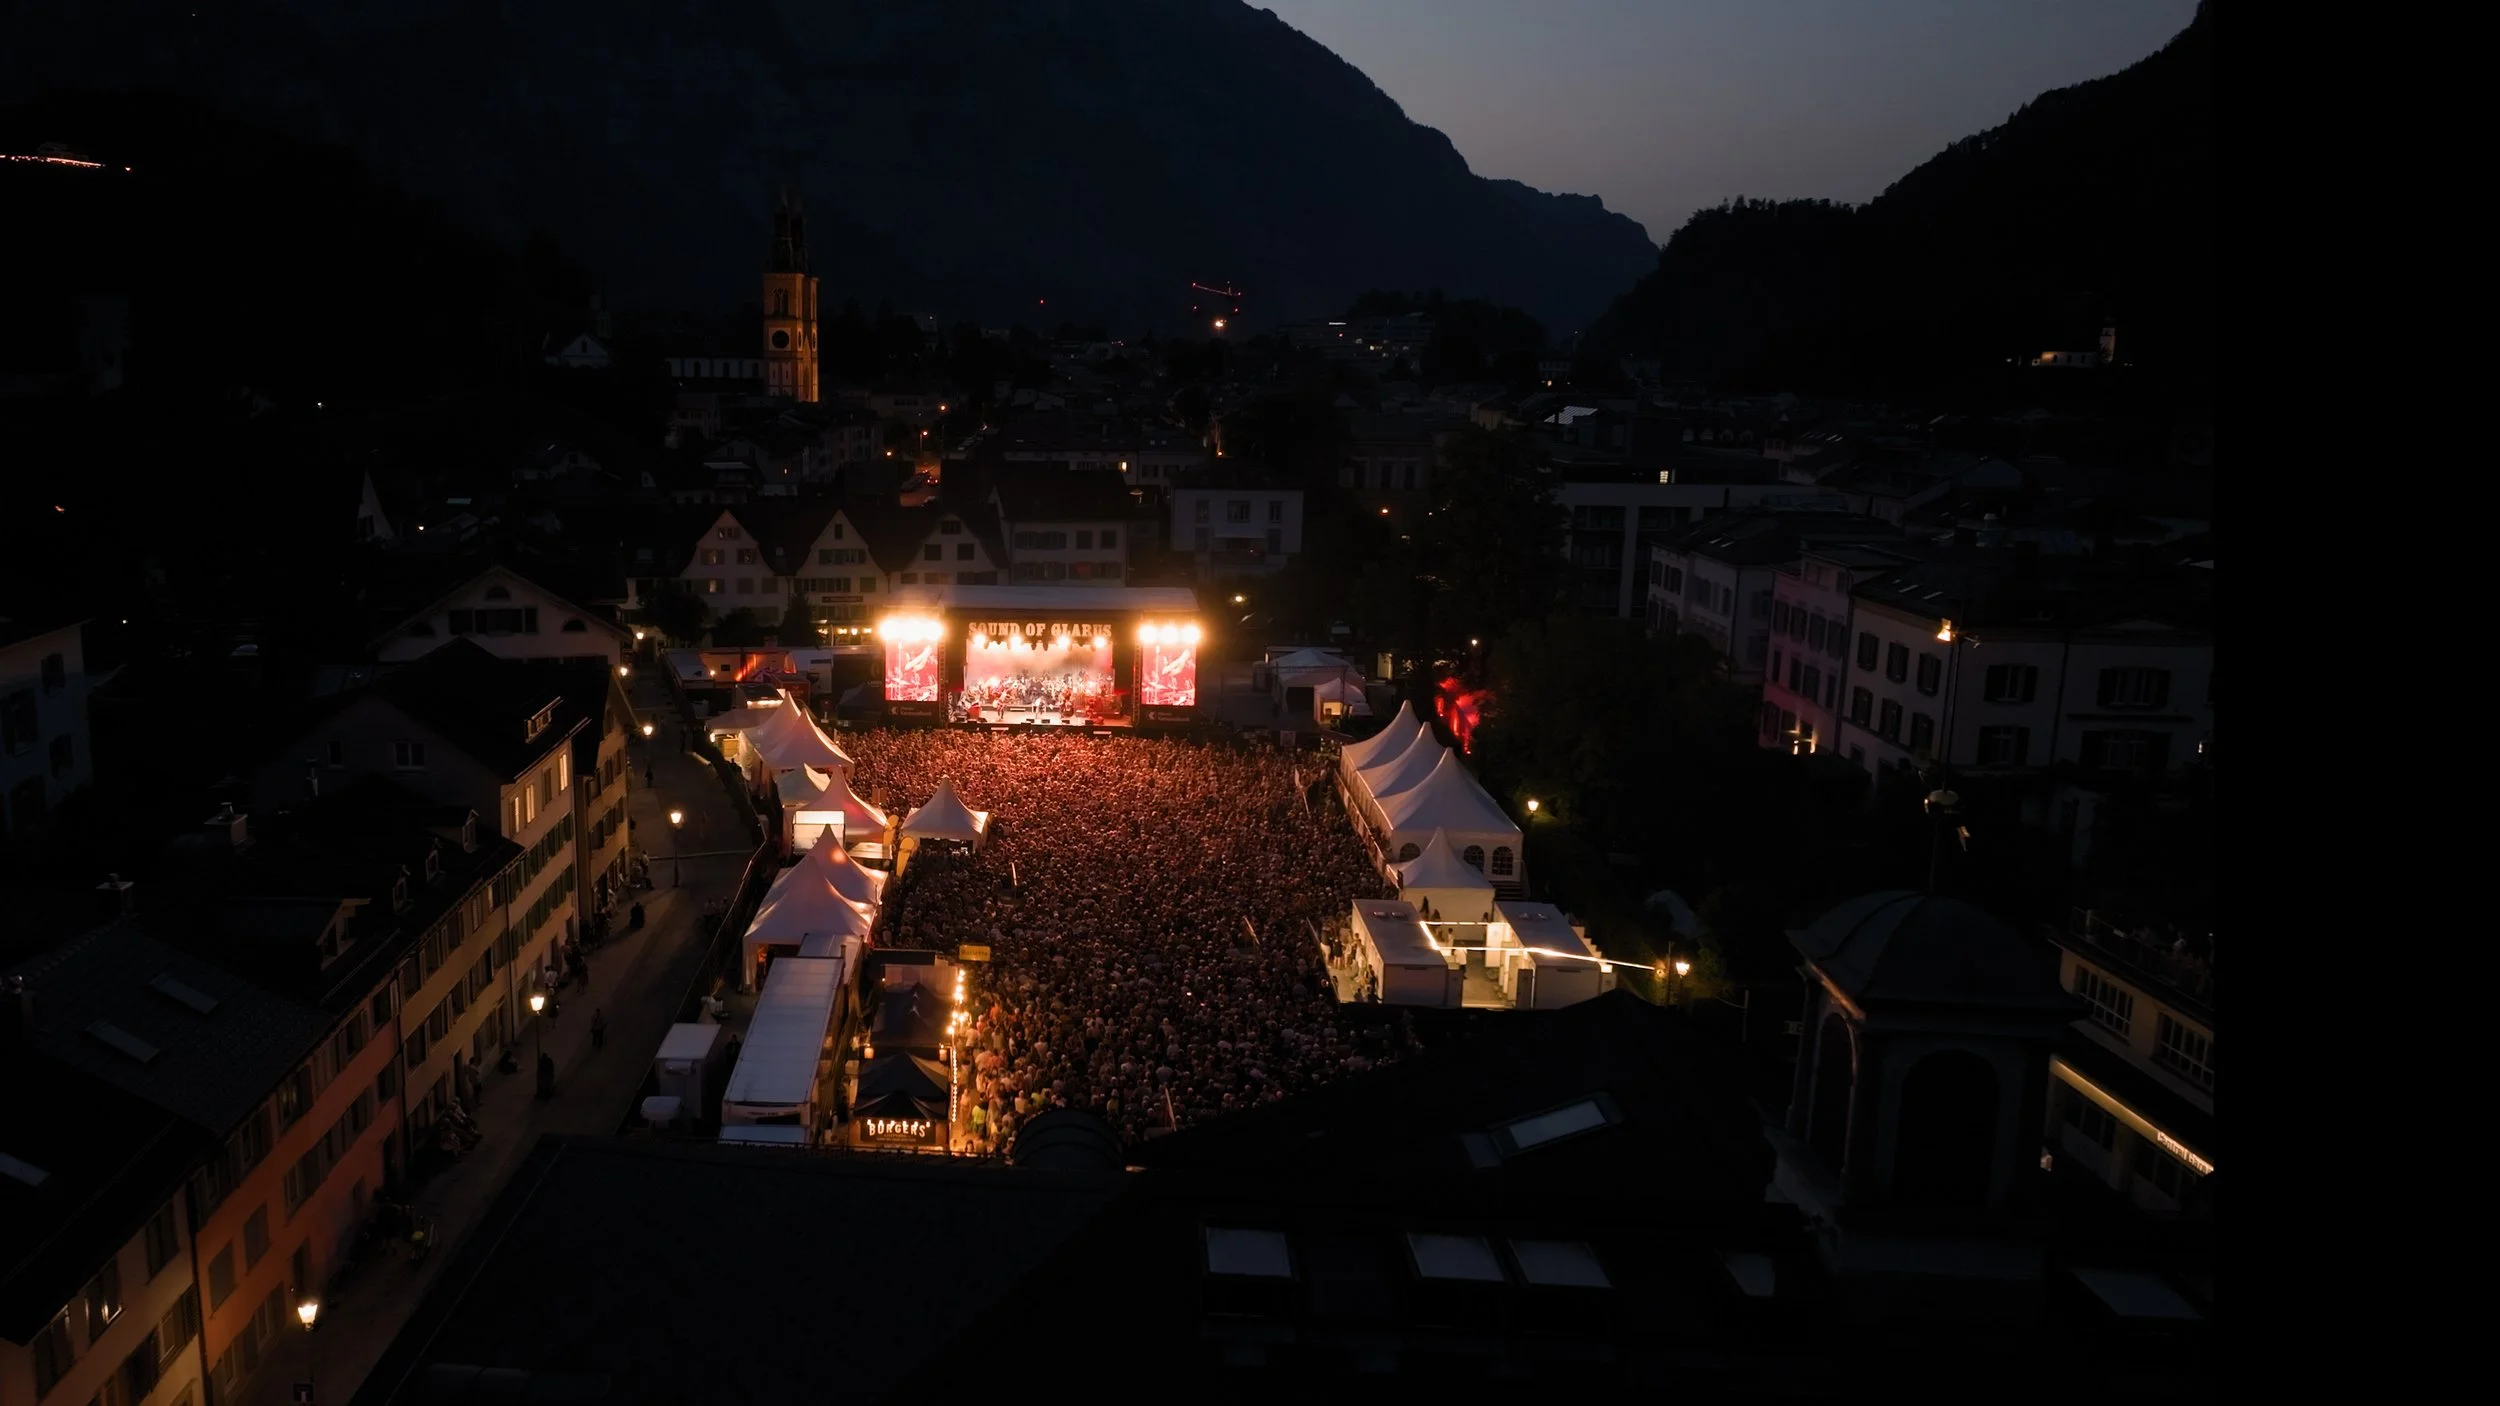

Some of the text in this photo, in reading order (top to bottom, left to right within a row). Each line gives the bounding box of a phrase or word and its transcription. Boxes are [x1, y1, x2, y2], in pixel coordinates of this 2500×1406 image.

[968, 622, 1112, 637] SOUND OF GLARUS
